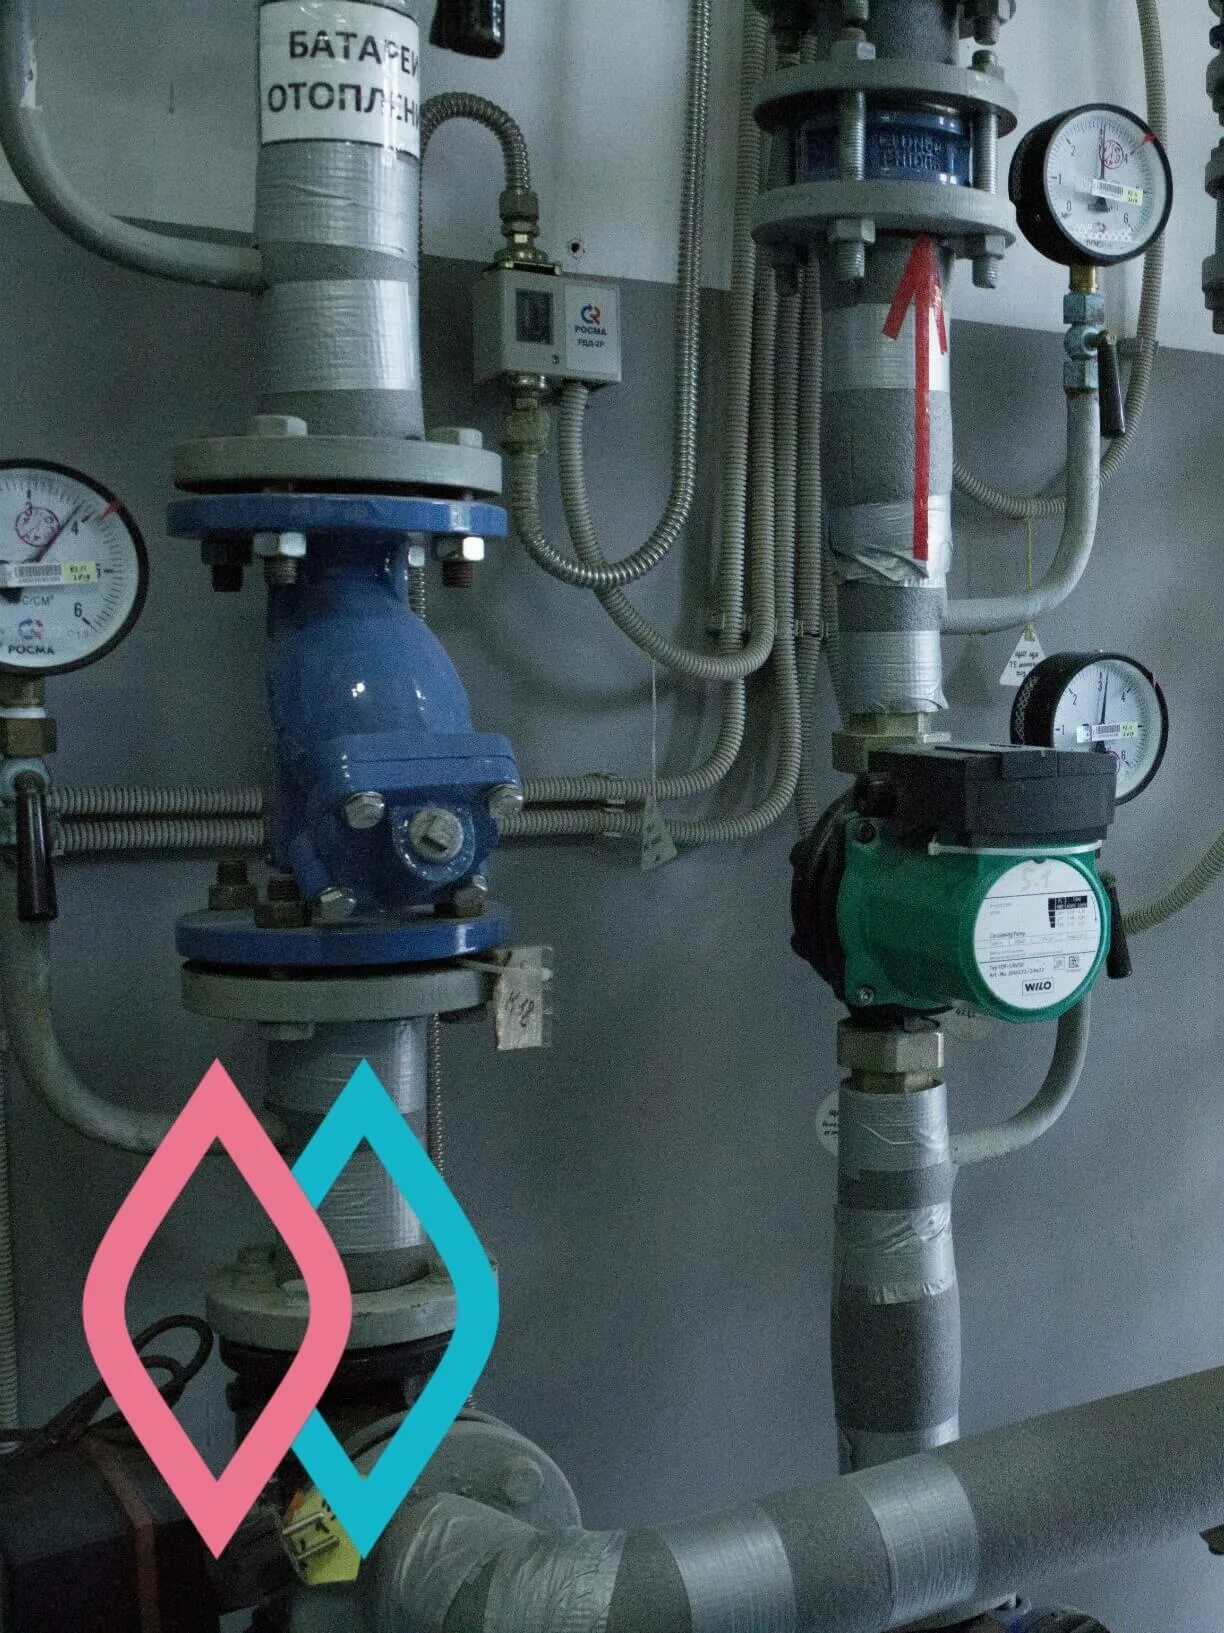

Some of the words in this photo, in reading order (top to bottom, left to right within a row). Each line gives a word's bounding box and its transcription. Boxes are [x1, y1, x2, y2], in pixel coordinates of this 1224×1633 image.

[74, 602, 83, 618] 6
[8, 645, 56, 655] РОСМА
[1024, 980, 1052, 992] WILO
